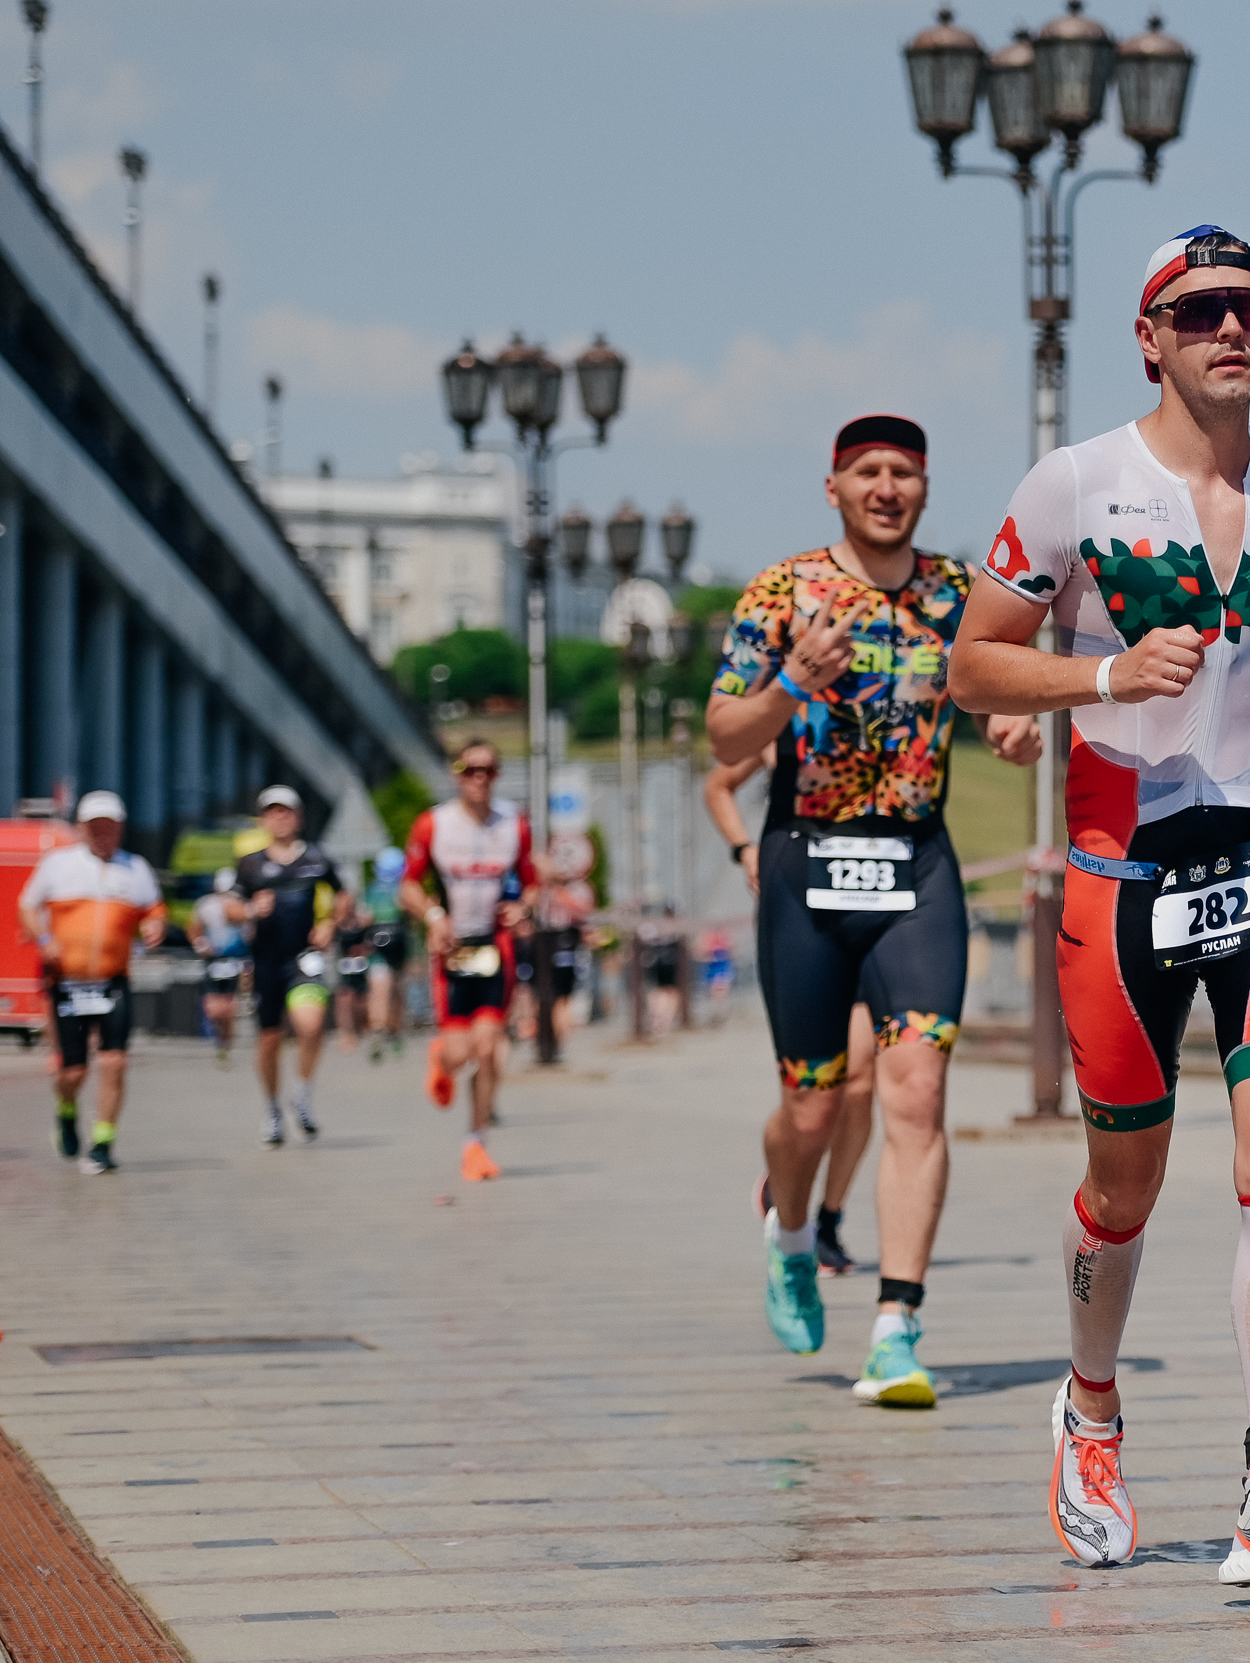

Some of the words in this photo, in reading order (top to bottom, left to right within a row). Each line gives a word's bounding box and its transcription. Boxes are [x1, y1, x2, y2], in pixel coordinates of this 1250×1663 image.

[827, 859, 896, 891] 1293
[1201, 935, 1241, 954] РУСЛАН
[1080, 1265, 1094, 1305] SPORT
